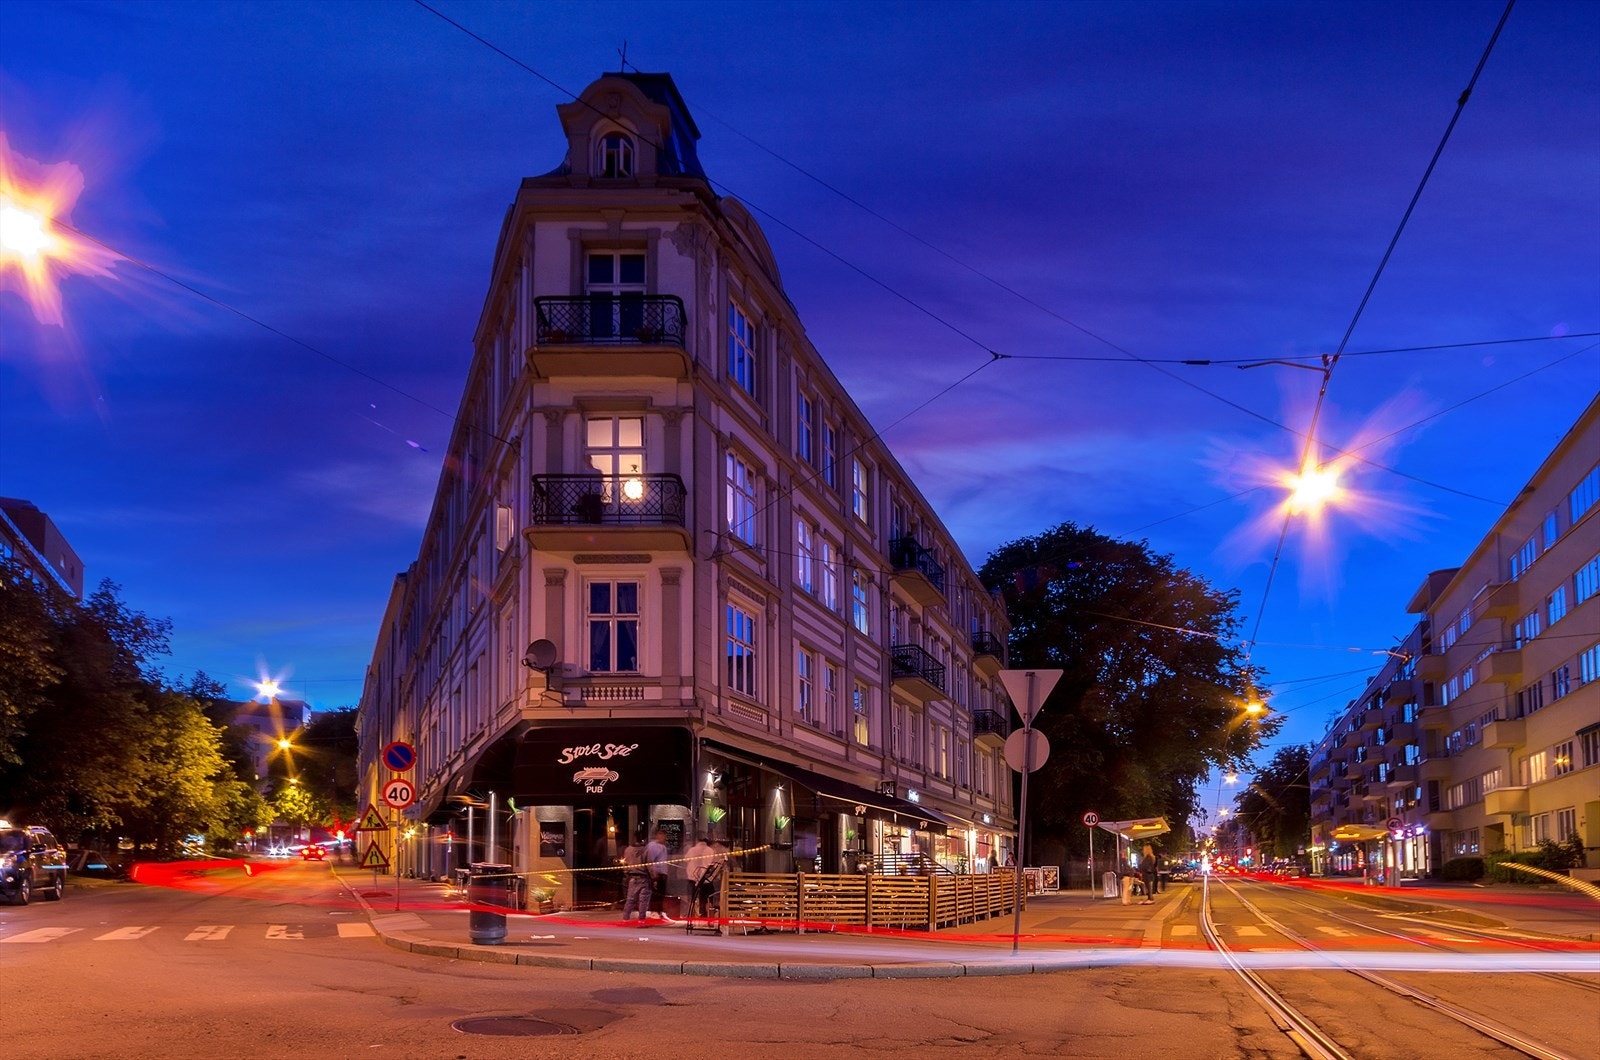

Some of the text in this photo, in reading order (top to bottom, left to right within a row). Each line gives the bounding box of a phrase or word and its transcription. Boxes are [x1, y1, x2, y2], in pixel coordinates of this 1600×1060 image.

[557, 743, 601, 764] Store
[388, 787, 410, 801] 40
[1085, 815, 1096, 823] 40
